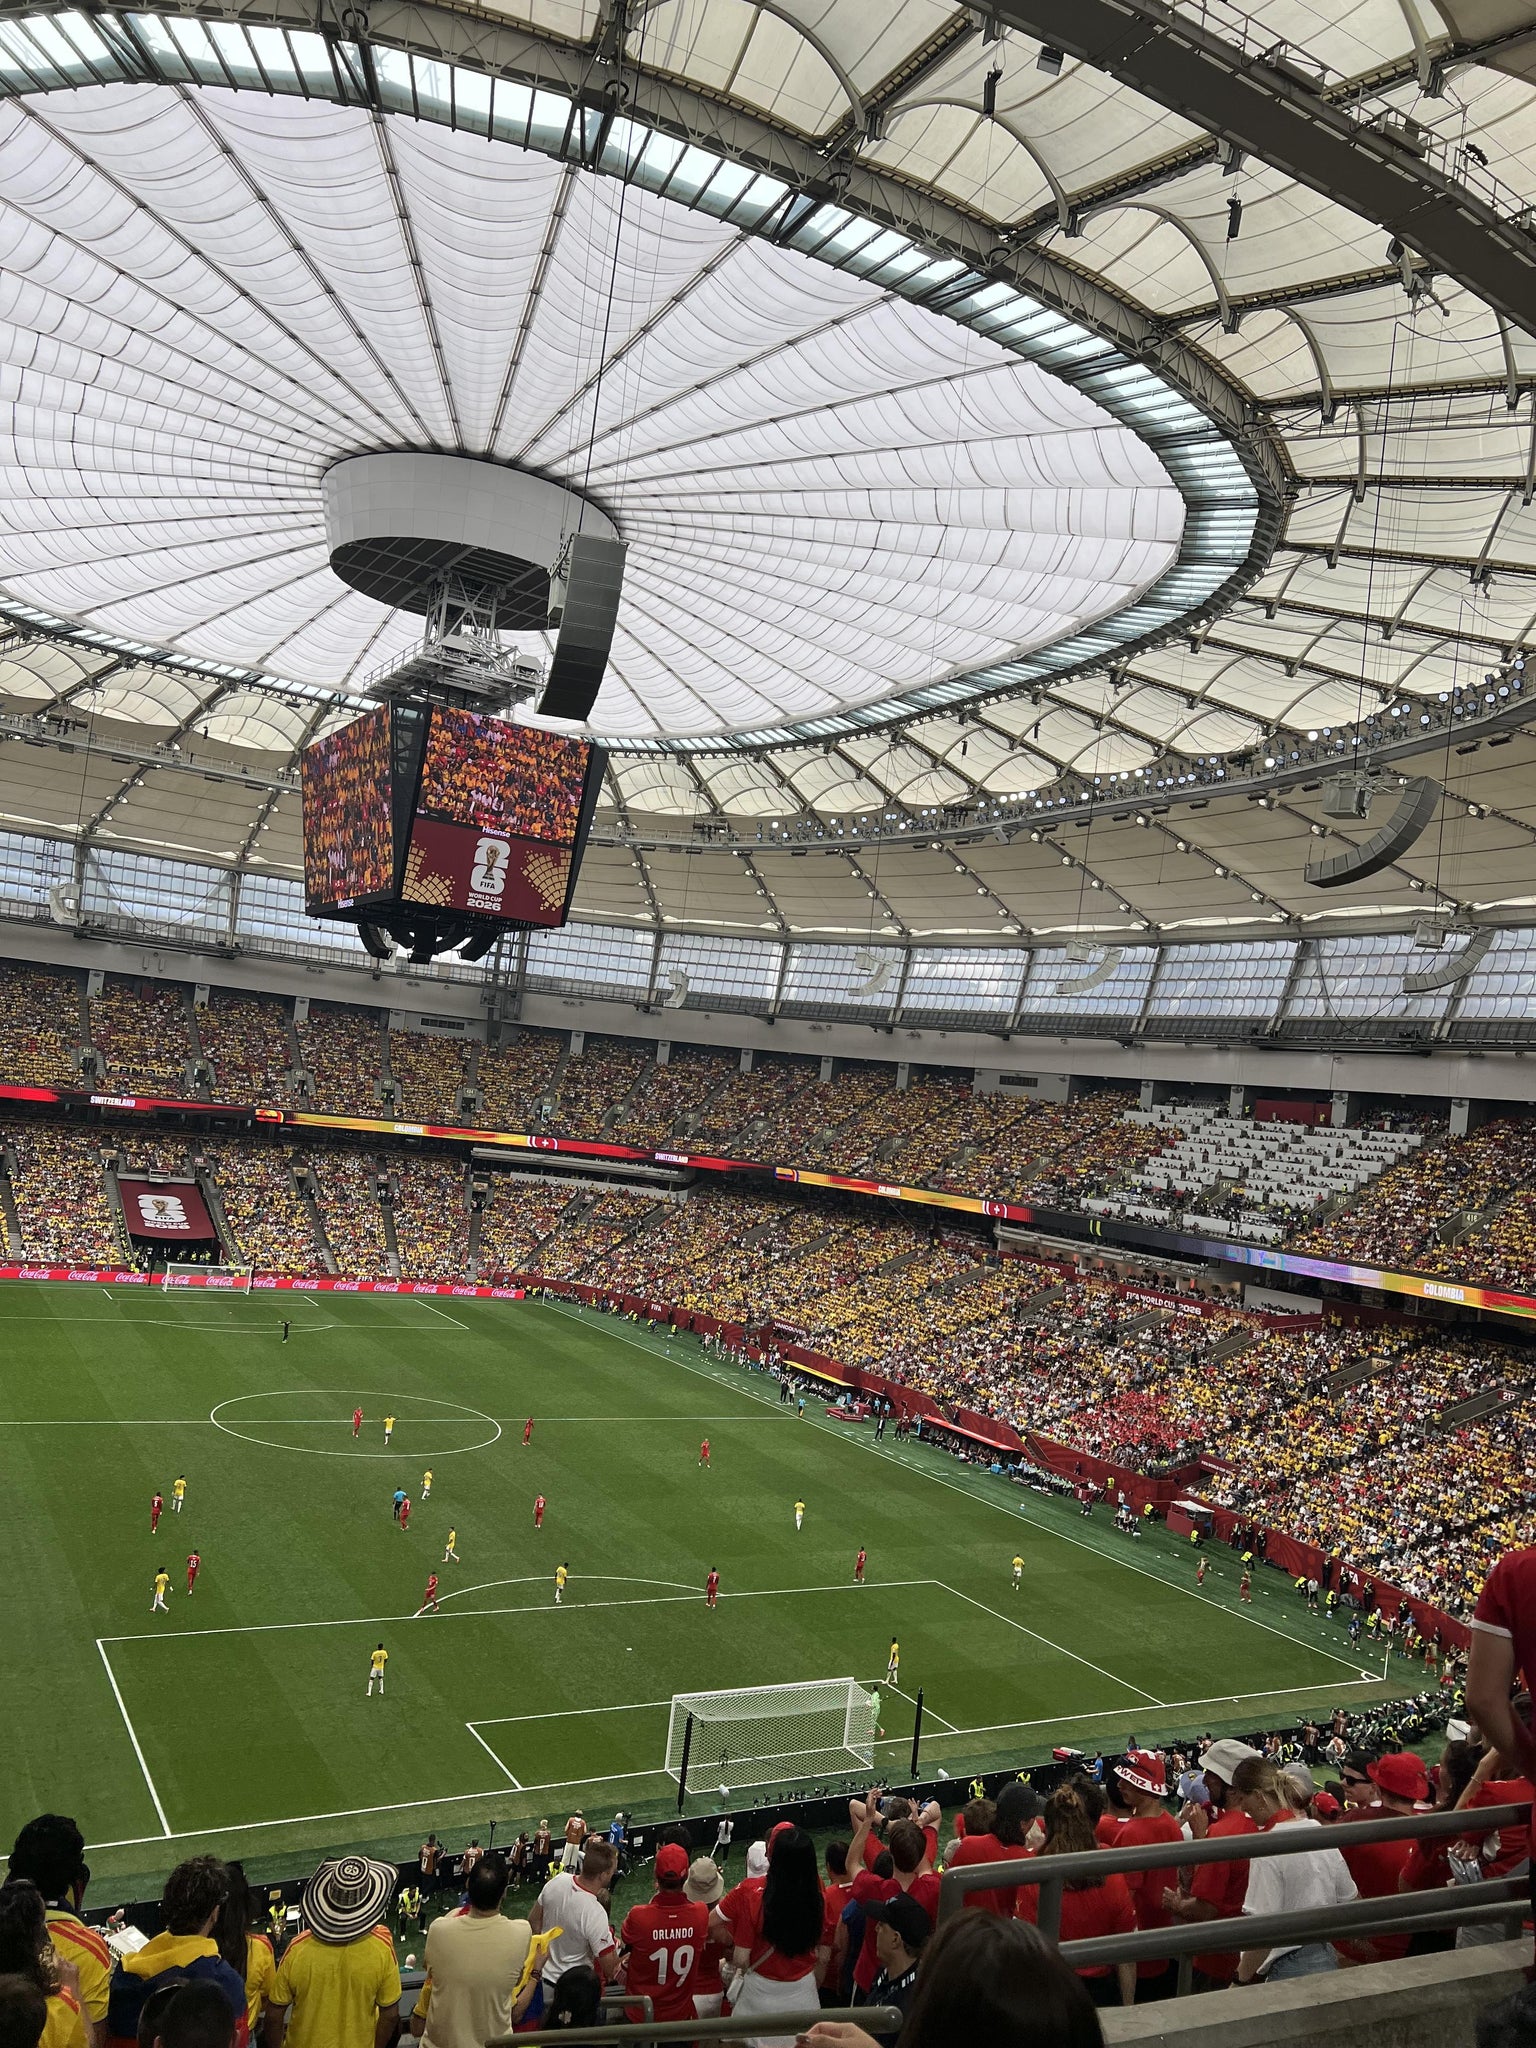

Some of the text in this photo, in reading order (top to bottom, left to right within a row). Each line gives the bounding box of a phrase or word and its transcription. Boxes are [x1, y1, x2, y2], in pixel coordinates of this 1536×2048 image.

[482, 826, 511, 838] Hisense
[480, 881, 496, 890] FIFA
[468, 892, 490, 901] WORLD
[466, 898, 502, 912] 2026
[90, 1095, 136, 1107] SWITZERLAND
[654, 1152, 689, 1164] SWITZERLAND
[1423, 1283, 1465, 1301] COLOMBIA
[651, 1303, 662, 1312] FIFA
[1126, 1291, 1140, 1301] FIFA
[1140, 1294, 1163, 1306] WORLD
[1178, 1303, 1202, 1315] 2026
[1502, 1392, 1516, 1401] 217
[190, 1560, 197, 1568] 15
[652, 1926, 694, 1941] ORLANDO
[648, 1944, 695, 1988] 19
